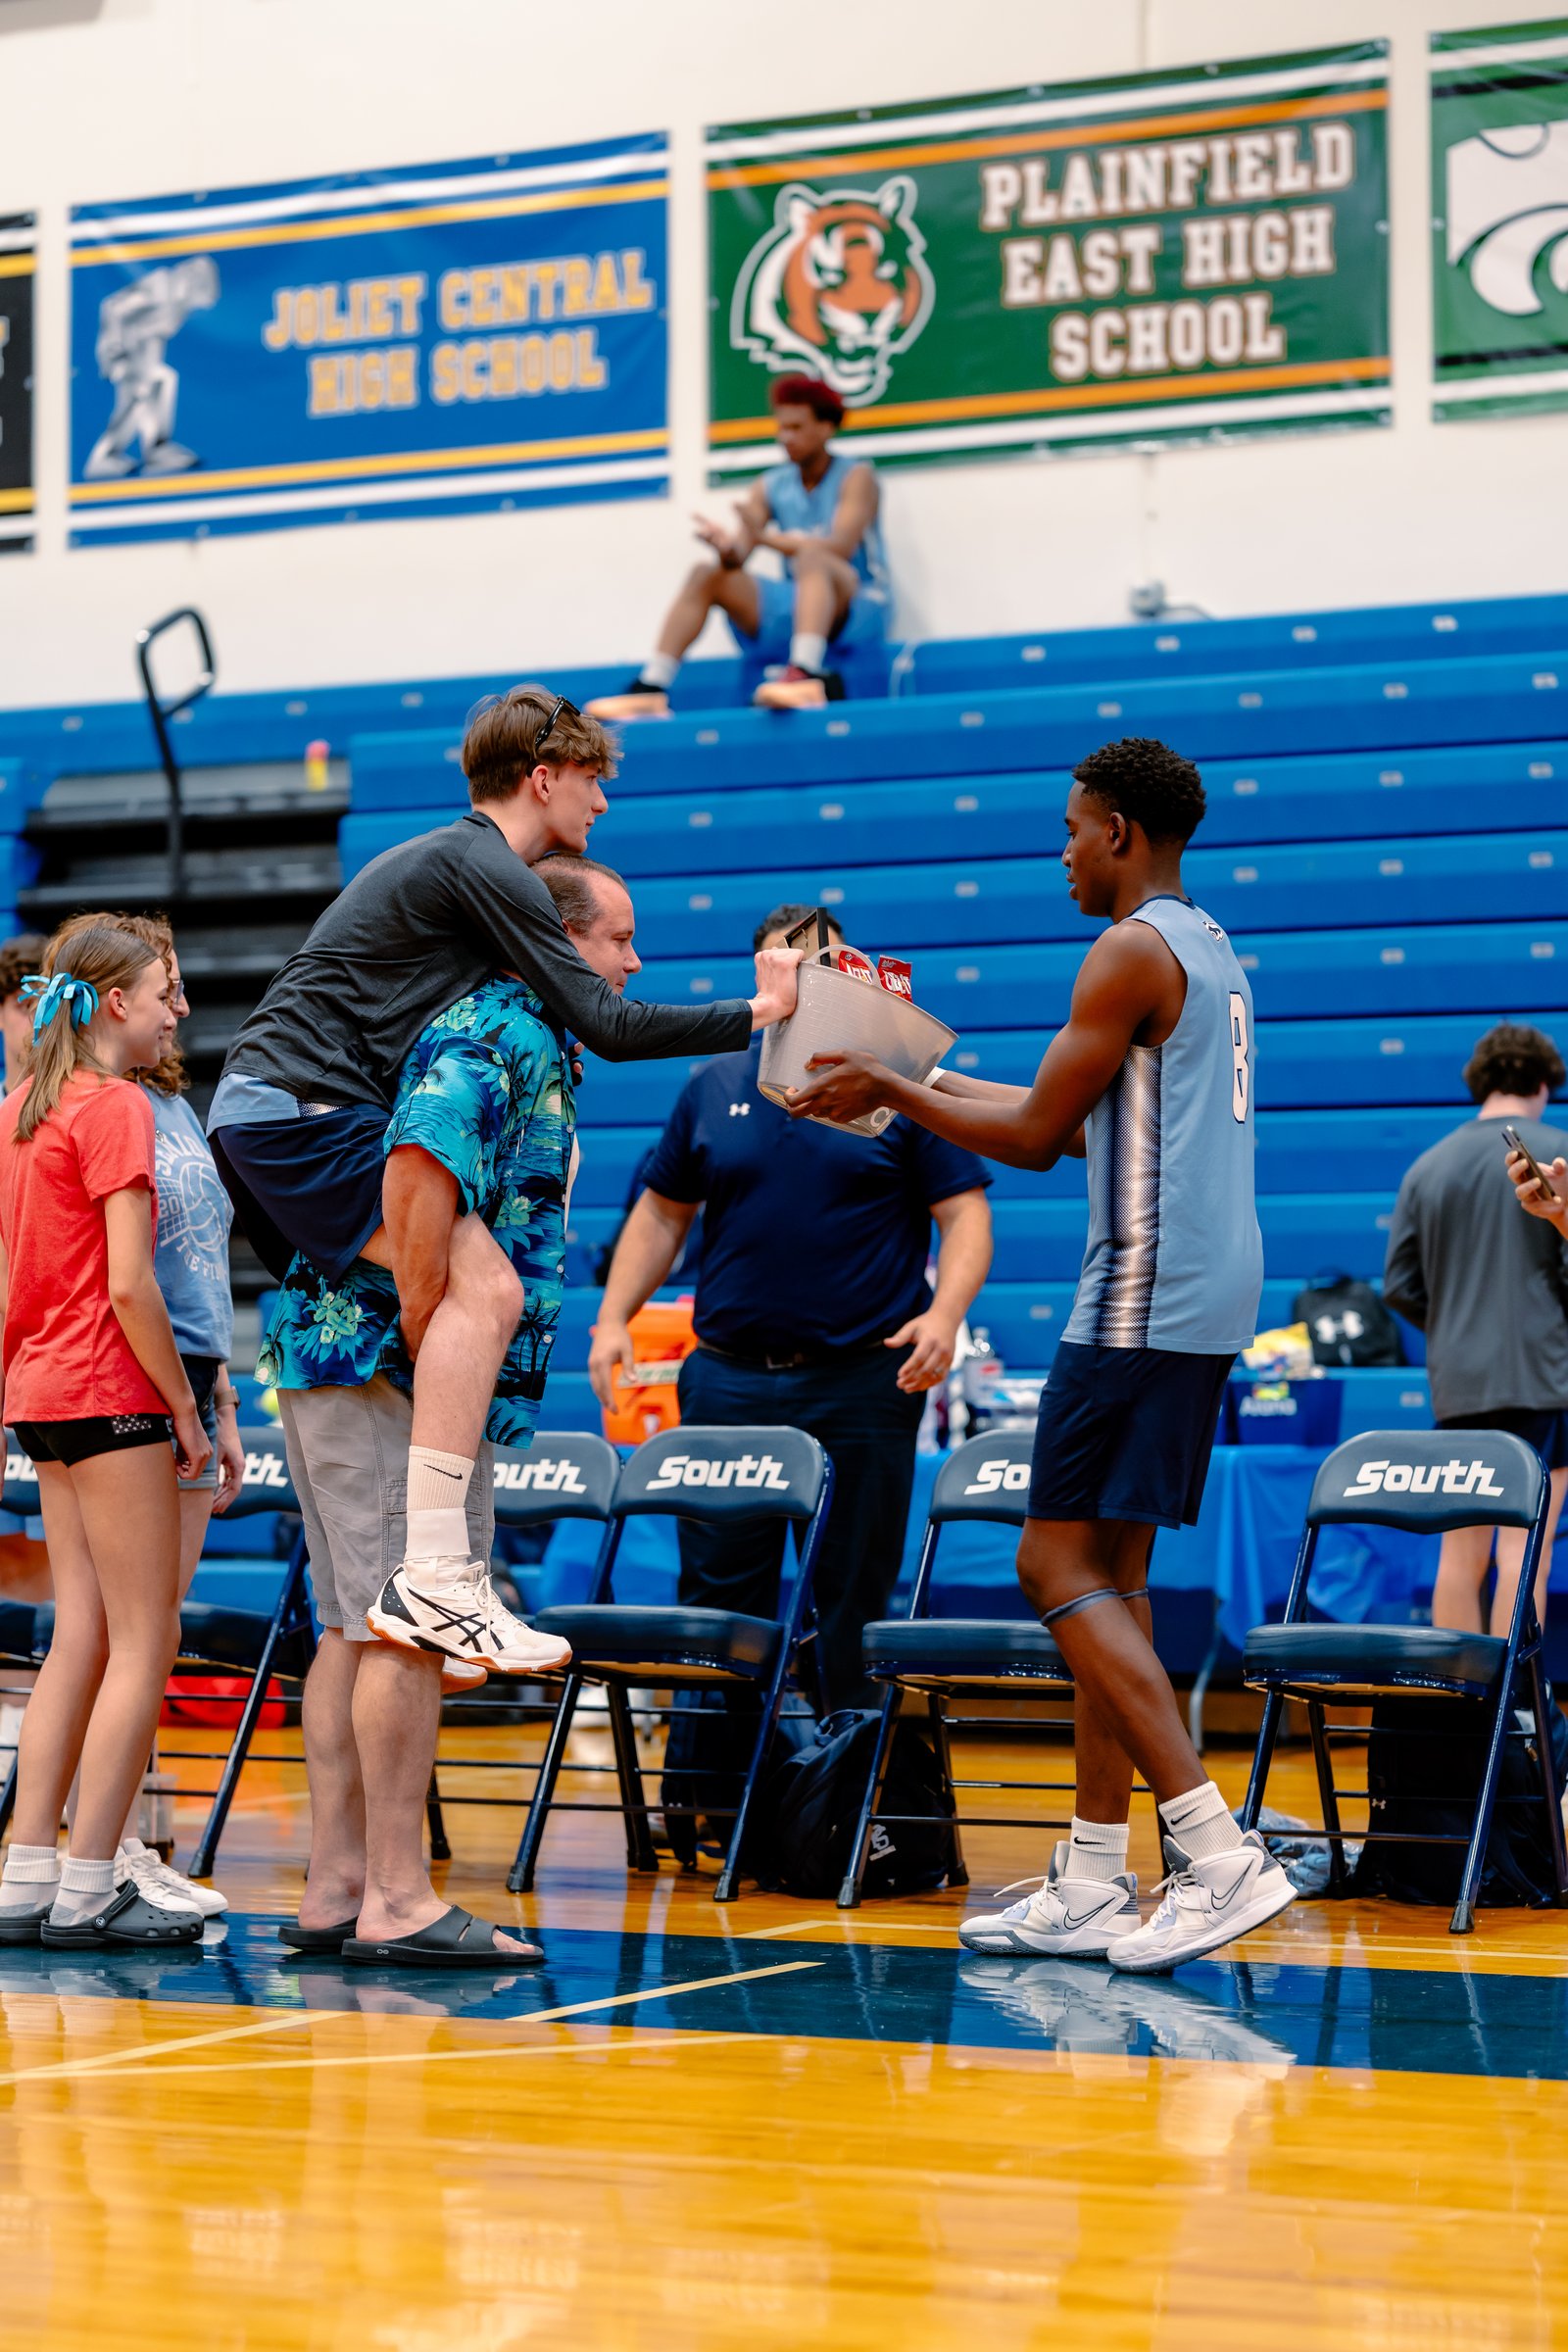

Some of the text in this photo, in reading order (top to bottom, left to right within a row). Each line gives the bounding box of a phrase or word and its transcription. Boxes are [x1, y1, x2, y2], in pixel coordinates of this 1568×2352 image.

[979, 121, 1355, 231] PLAINFIELD
[262, 246, 656, 353] JOLIET CENTRAL
[1002, 203, 1337, 309] EAST HIGH
[307, 325, 610, 419] HIGH SCHOOL
[1049, 291, 1288, 382] SCHOOL
[493, 1458, 587, 1494] outh
[646, 1454, 790, 1491] South
[1343, 1459, 1505, 1497] South
